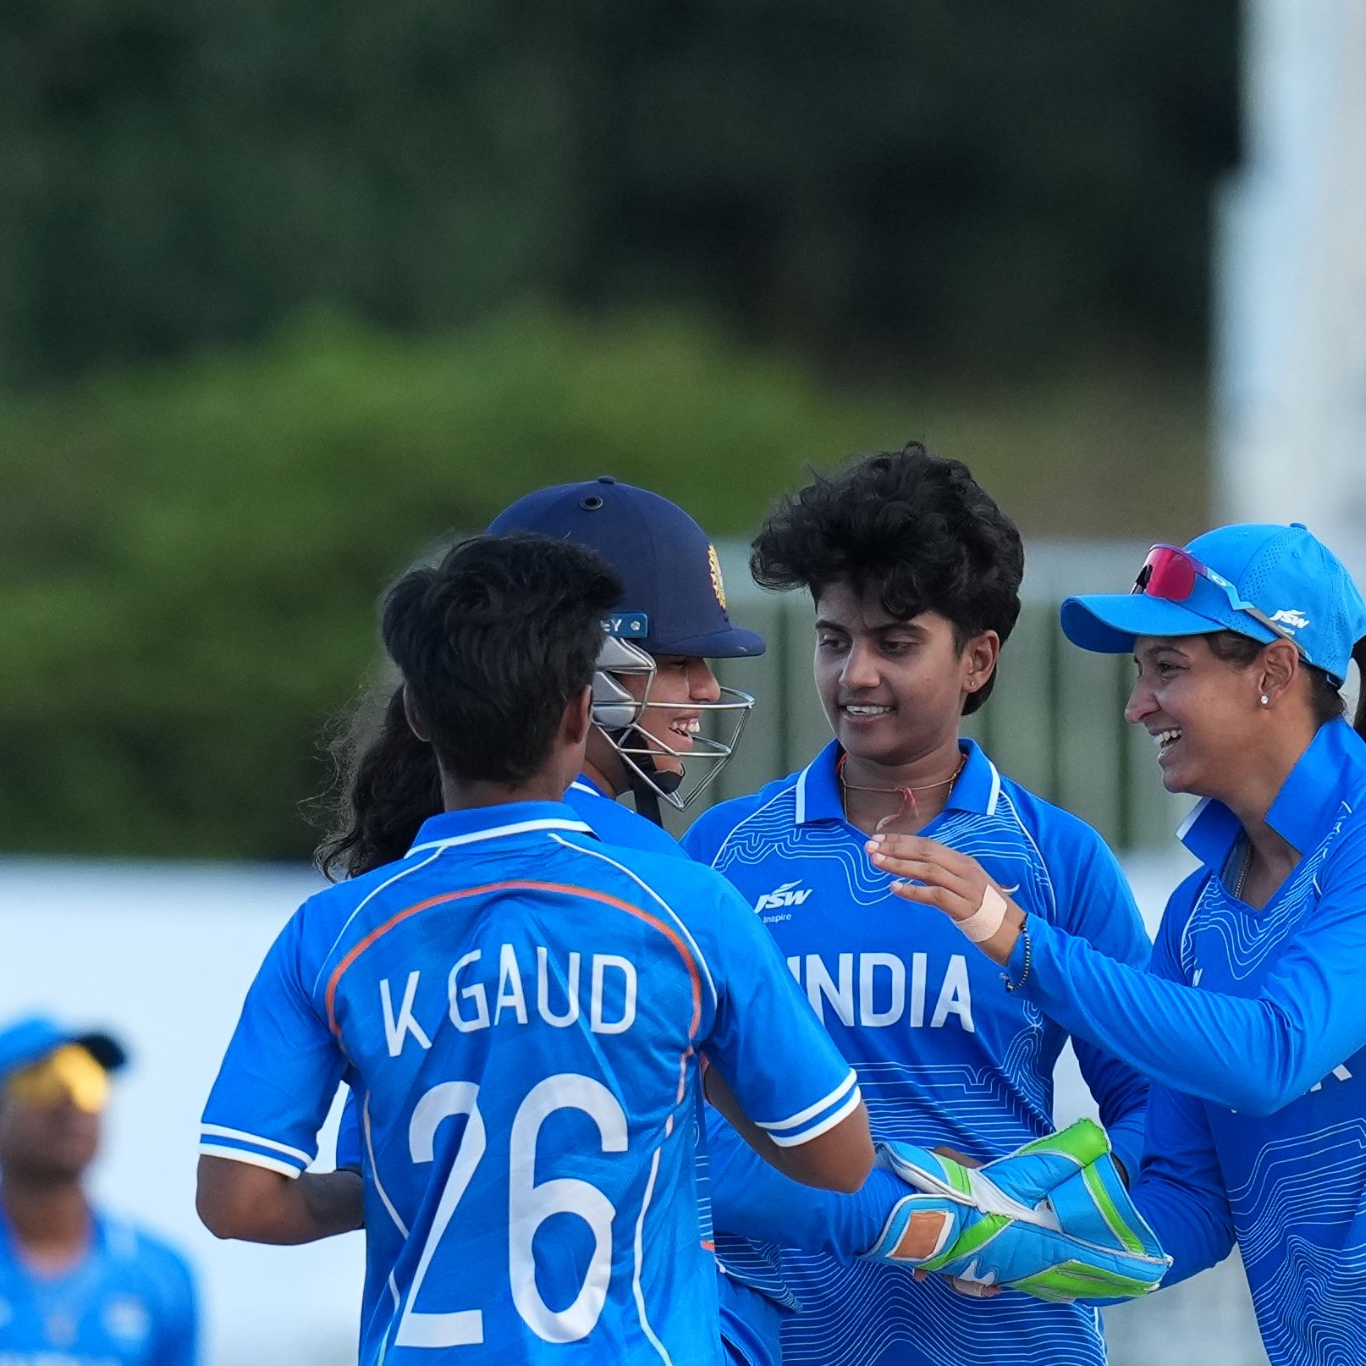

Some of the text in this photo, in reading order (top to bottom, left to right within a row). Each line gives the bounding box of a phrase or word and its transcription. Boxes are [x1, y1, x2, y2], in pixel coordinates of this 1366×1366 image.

[754, 887, 813, 914] JSW
[763, 912, 792, 924] Inspire
[379, 943, 637, 1057] K GAUD
[786, 952, 975, 1033] NDIA
[394, 1073, 629, 1348] 26
